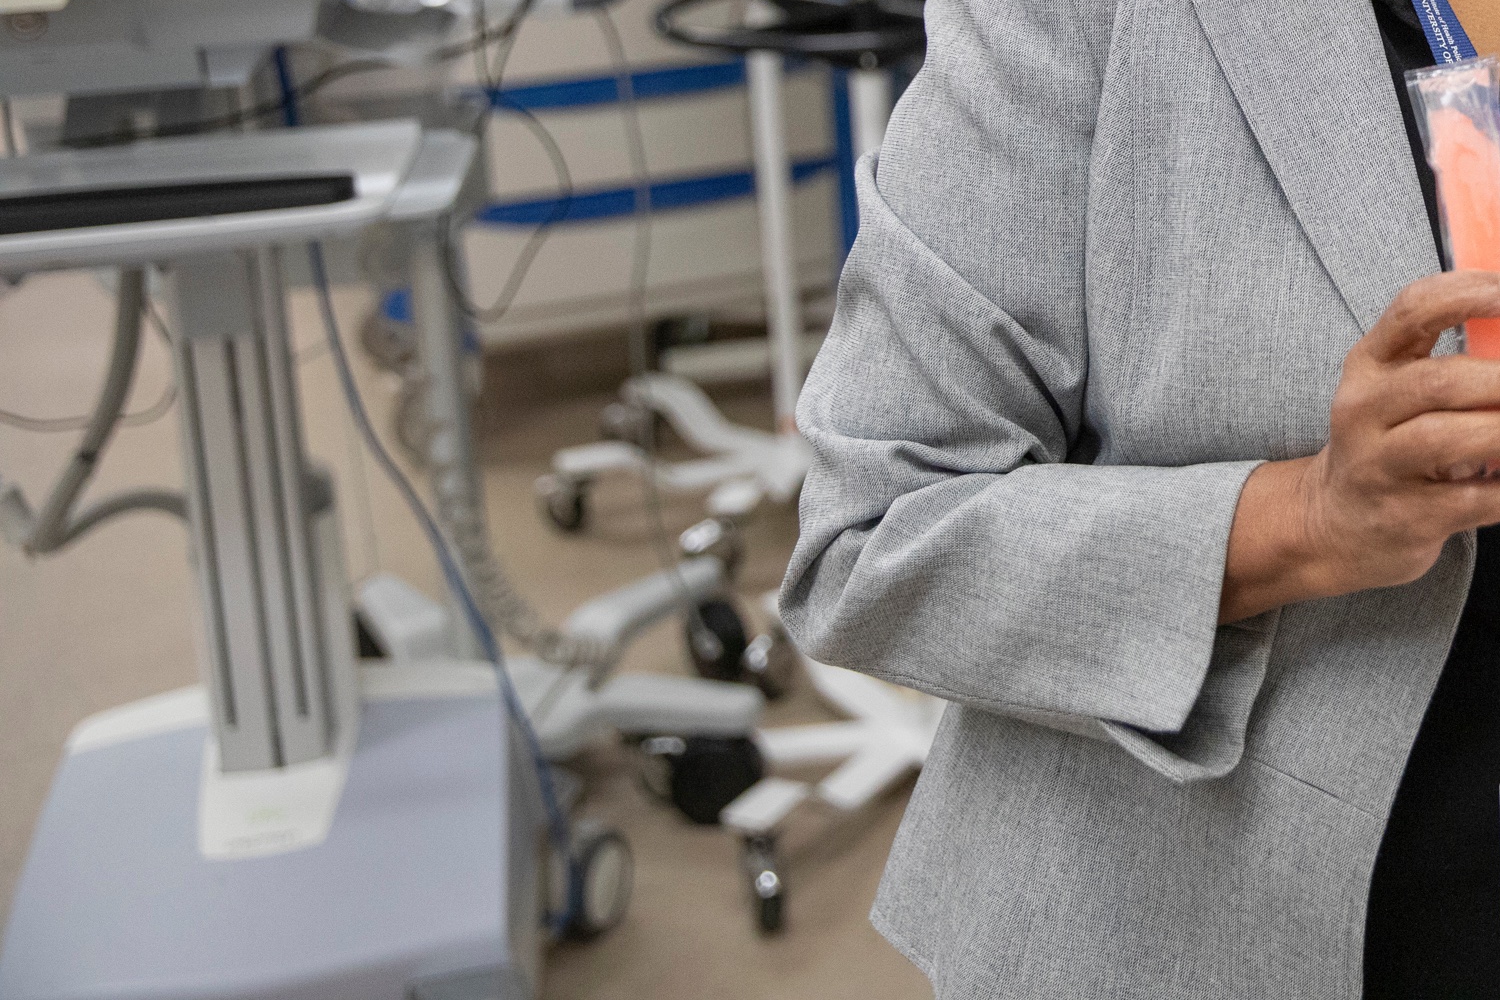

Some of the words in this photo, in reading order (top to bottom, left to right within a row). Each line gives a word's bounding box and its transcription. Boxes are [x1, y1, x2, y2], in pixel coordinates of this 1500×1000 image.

[1442, 24, 1454, 44] Health
[1451, 45, 1462, 62] Polic
[1442, 51, 1454, 64] OF
